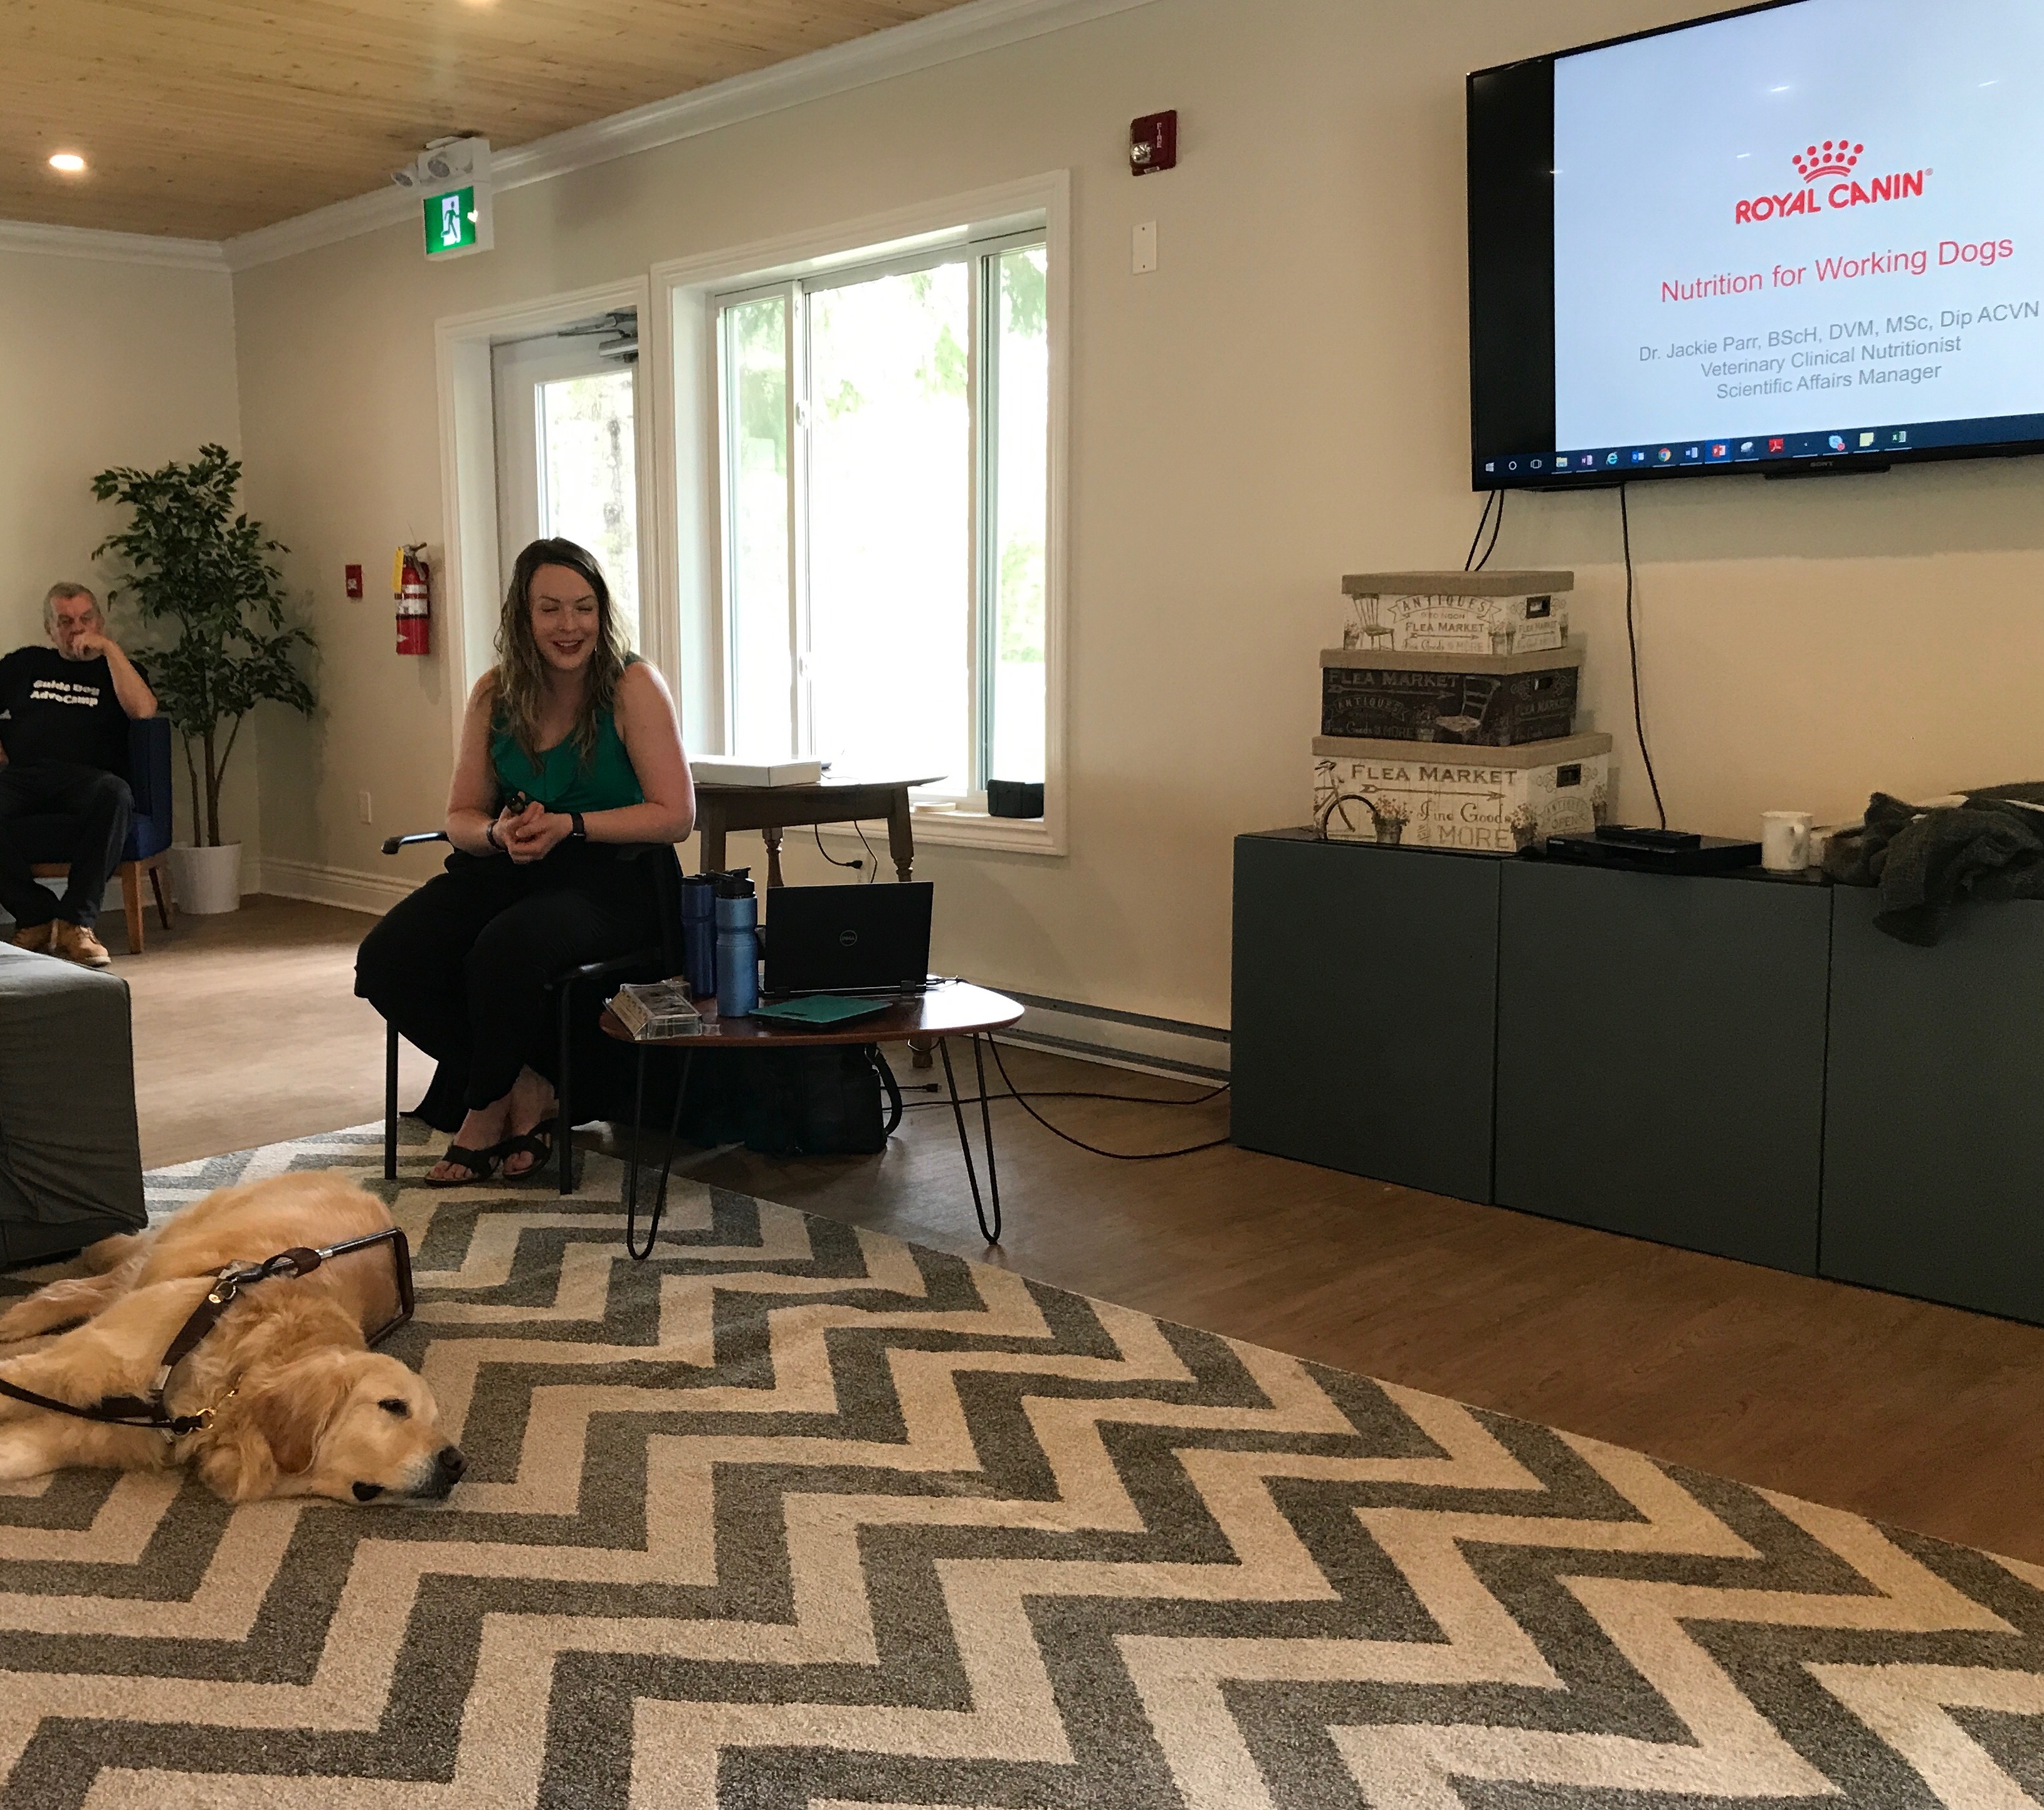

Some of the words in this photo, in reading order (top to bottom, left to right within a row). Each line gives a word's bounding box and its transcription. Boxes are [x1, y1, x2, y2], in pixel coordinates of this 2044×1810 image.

[1736, 188, 1821, 225] ROYAL
[1662, 270, 1762, 302] Nutrition
[1772, 265, 1806, 287] for
[1815, 249, 1927, 282] Working
[1939, 239, 2013, 267] Dogs
[1640, 346, 1660, 361] Dr.
[1667, 339, 1717, 359] Jackie
[1723, 336, 1761, 352] Parr,
[1768, 326, 1822, 347] BScH,
[1830, 320, 1879, 340] DVM,
[1886, 315, 1934, 334] MSc,
[1941, 310, 1973, 329] Dip
[1977, 300, 2039, 324] ACVN
[1700, 358, 1786, 377] Veterinary
[1791, 346, 1855, 368] Clinical
[1861, 336, 1962, 361] Nutritionist
[1717, 378, 1793, 399] Scientific
[1796, 372, 1852, 391] Affairs
[1858, 365, 1942, 385] Manager
[1403, 595, 1487, 613] ANTIQUES
[1406, 622, 1434, 632] FLEA
[1438, 622, 1485, 633] MARKET
[1328, 670, 1376, 685] FLEA
[1382, 672, 1460, 688] MARKET
[1338, 697, 1400, 712] ANTIQUES
[1351, 763, 1410, 781] FLEA
[1418, 766, 1517, 785] MARKET
[1416, 799, 1454, 822] Fine
[1551, 816, 1578, 830] OPEN
[1438, 825, 1510, 849] MORE
